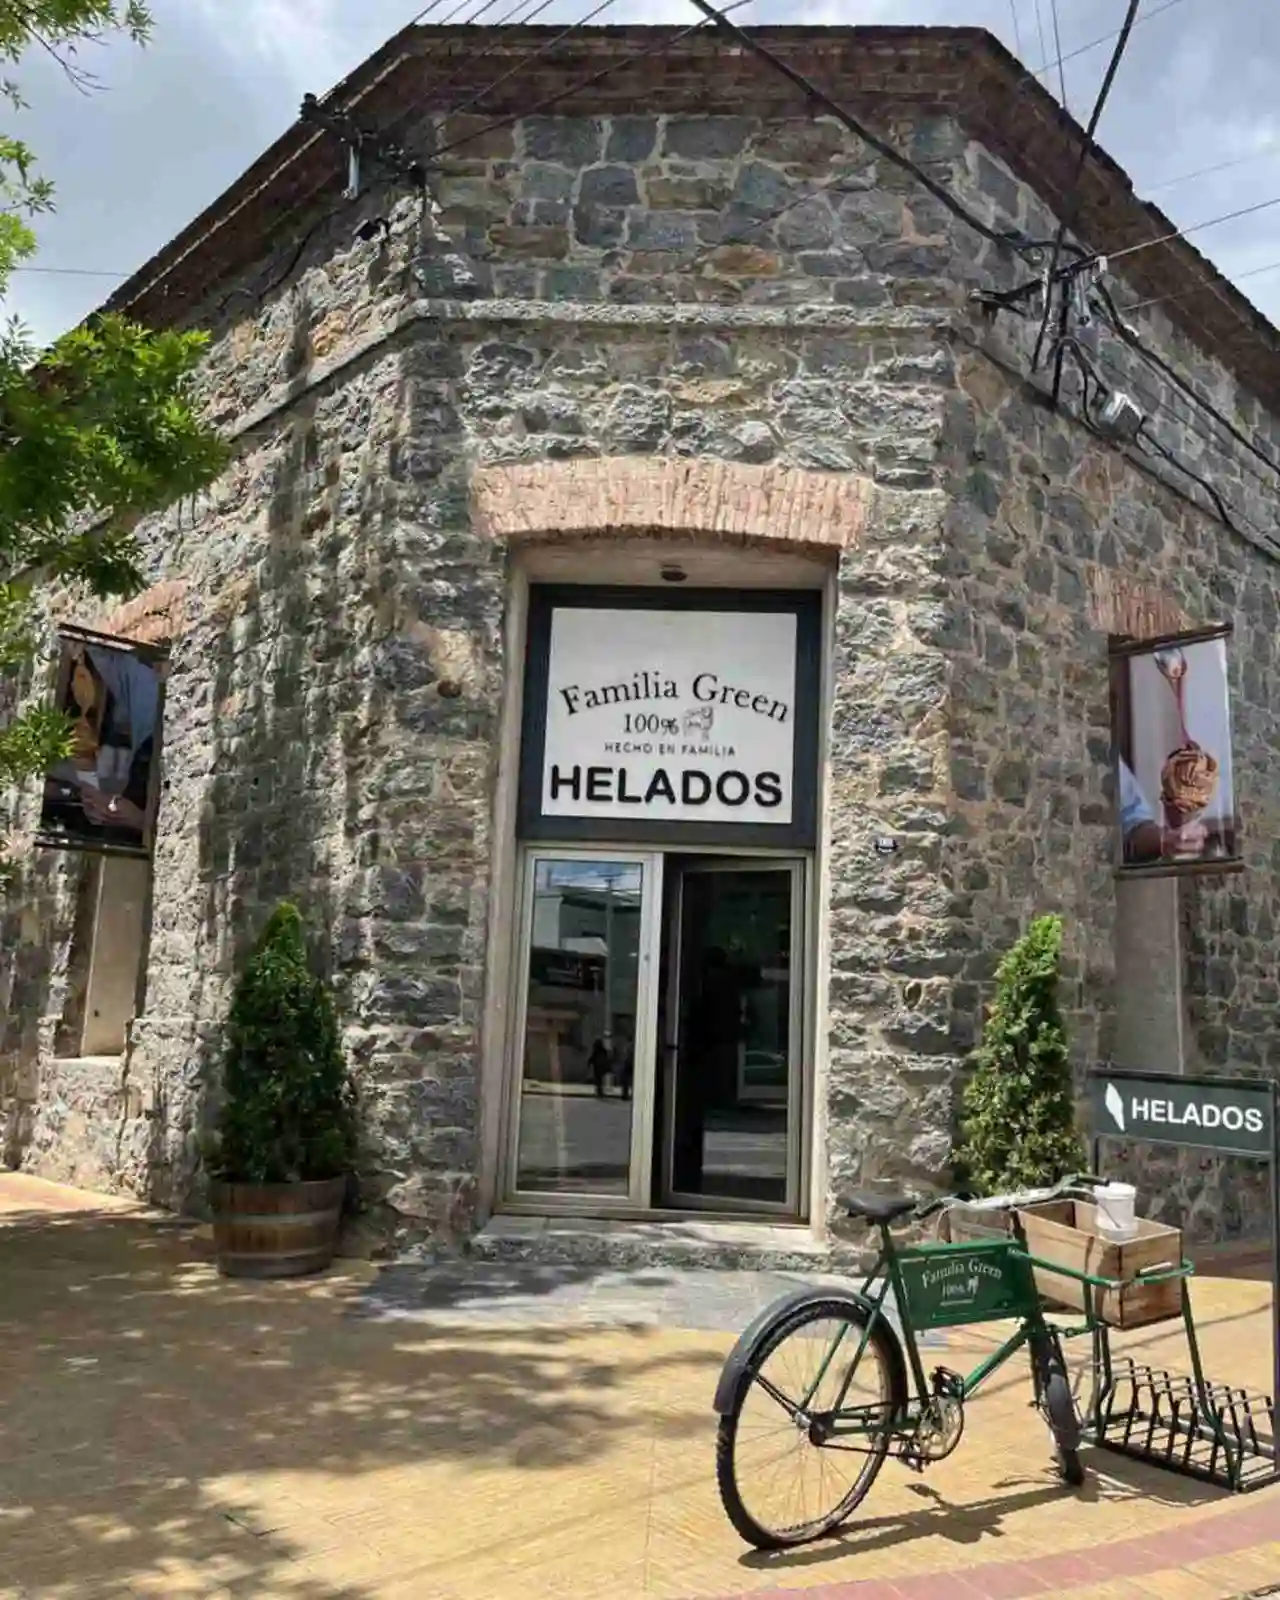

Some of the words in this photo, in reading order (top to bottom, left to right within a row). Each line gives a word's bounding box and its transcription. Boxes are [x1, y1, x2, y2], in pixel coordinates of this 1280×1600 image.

[559, 670, 680, 716] Familia
[692, 672, 789, 723] Green
[623, 713, 680, 735] 100%
[604, 741, 653, 755] HECHO
[658, 743, 676, 756] EN
[682, 744, 736, 758] FAMILIA
[551, 764, 783, 808] HELADOS
[1131, 1096, 1265, 1133] HELADOS
